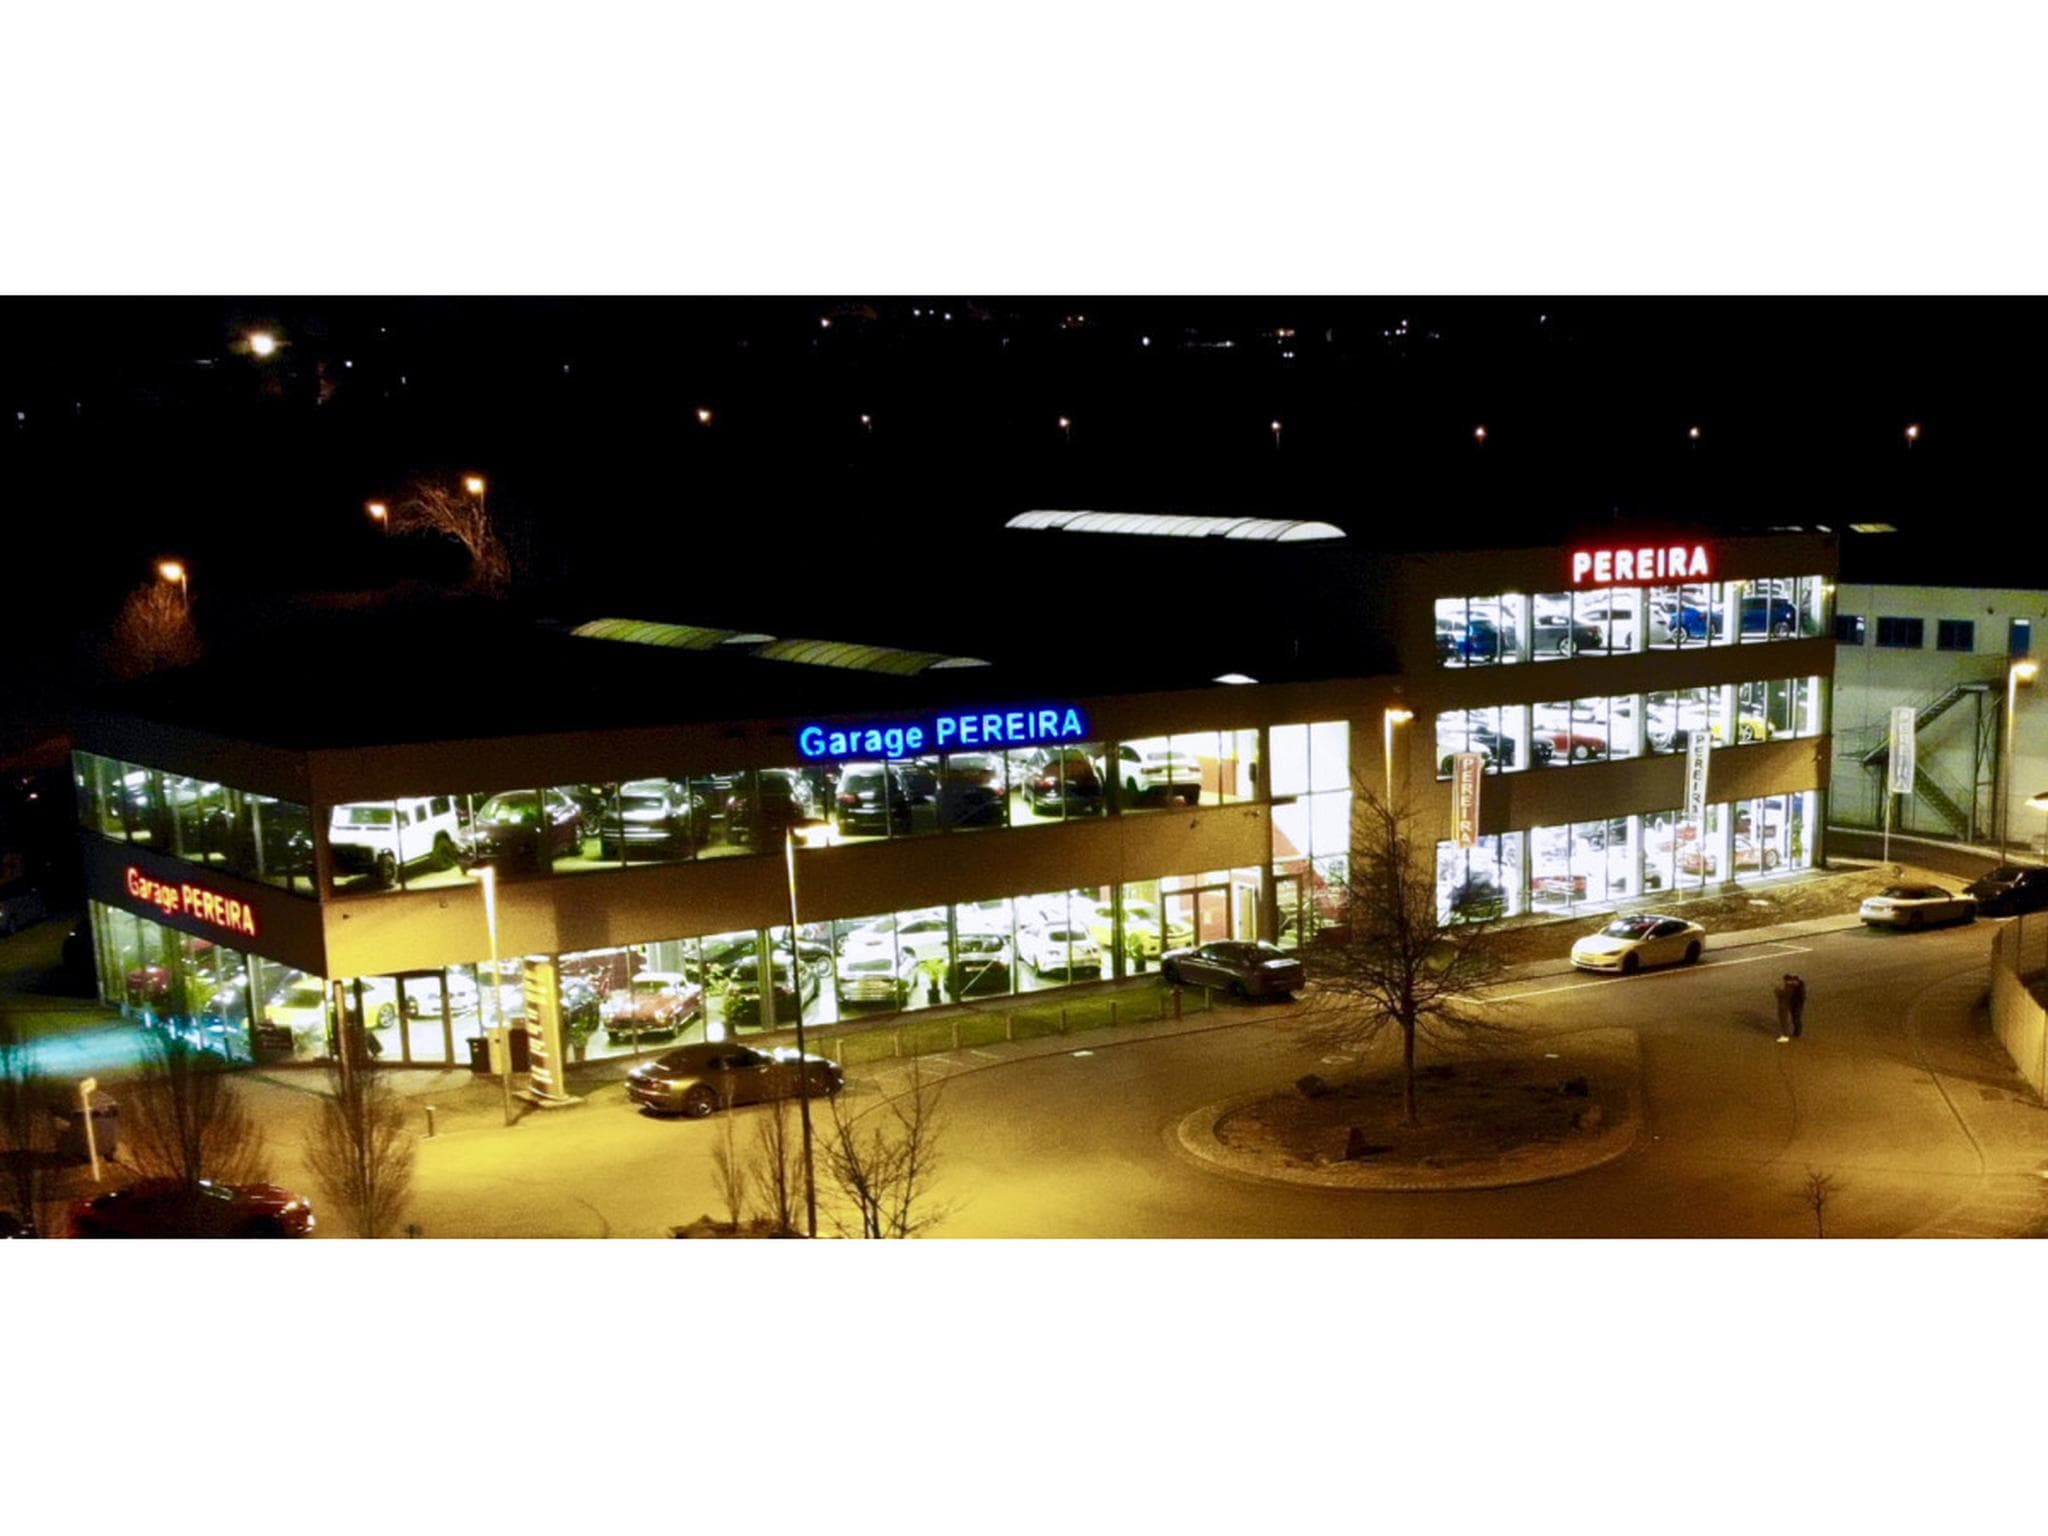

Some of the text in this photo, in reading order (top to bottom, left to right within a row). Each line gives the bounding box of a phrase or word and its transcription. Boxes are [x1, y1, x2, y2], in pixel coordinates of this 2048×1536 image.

[1573, 546, 1709, 583] PEREIRA
[800, 709, 1082, 757] Garage PEREIRA
[127, 867, 255, 937] Garage PEREIRA
